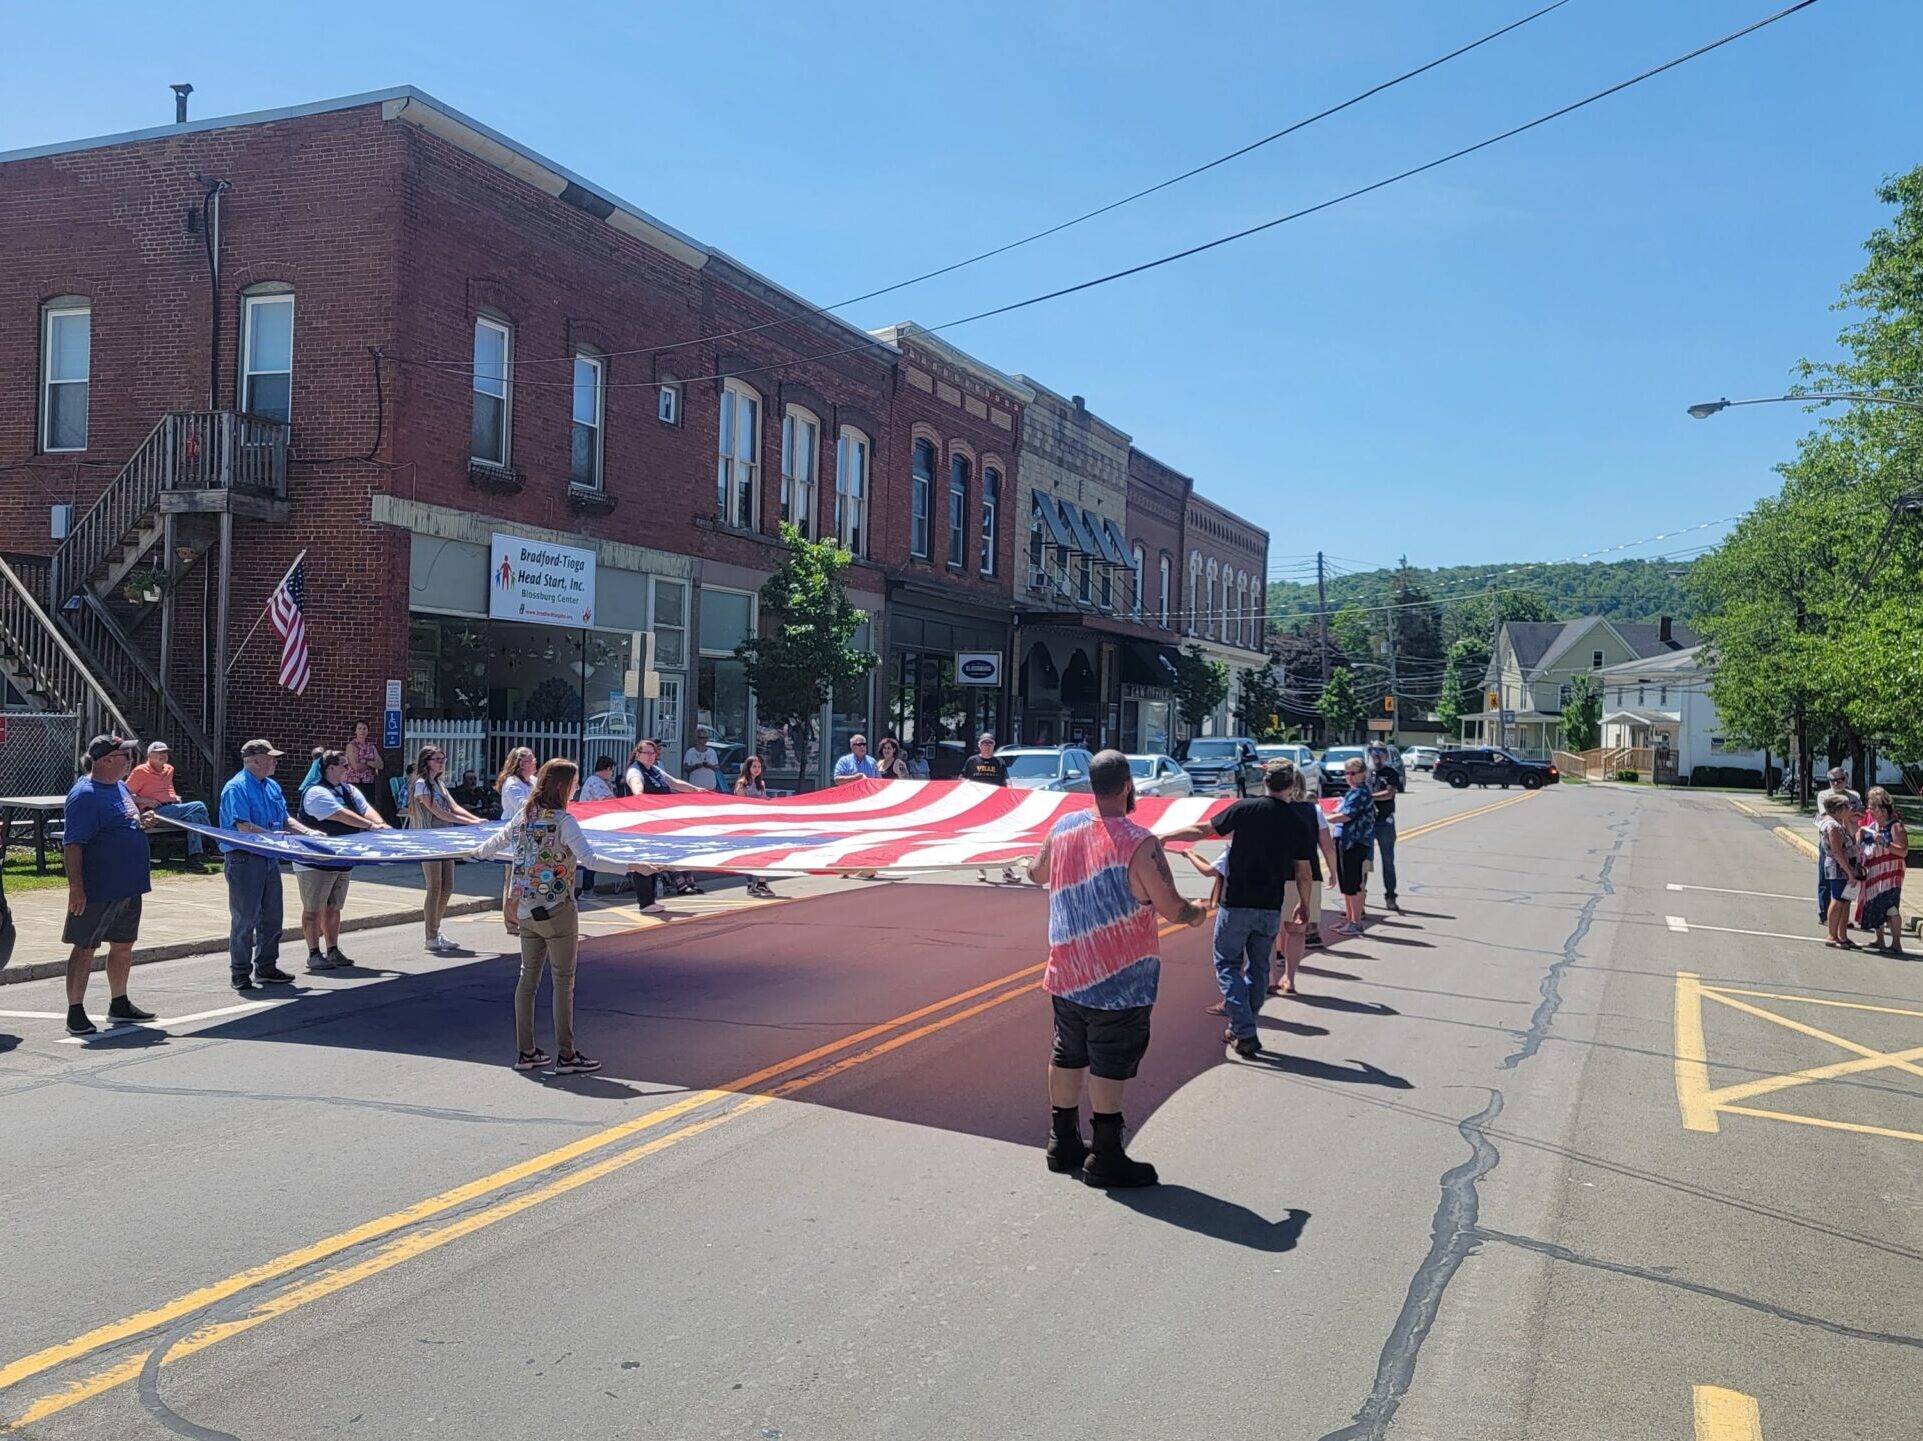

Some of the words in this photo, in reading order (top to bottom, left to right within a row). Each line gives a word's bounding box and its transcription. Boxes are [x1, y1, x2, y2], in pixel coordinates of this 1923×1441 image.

[520, 548, 585, 573] Bradford-Tioga
[518, 569, 542, 586] Head
[544, 573, 567, 592] Start,
[570, 578, 585, 592] Inc.
[521, 589, 556, 603] Blossburg
[557, 594, 580, 605] Center
